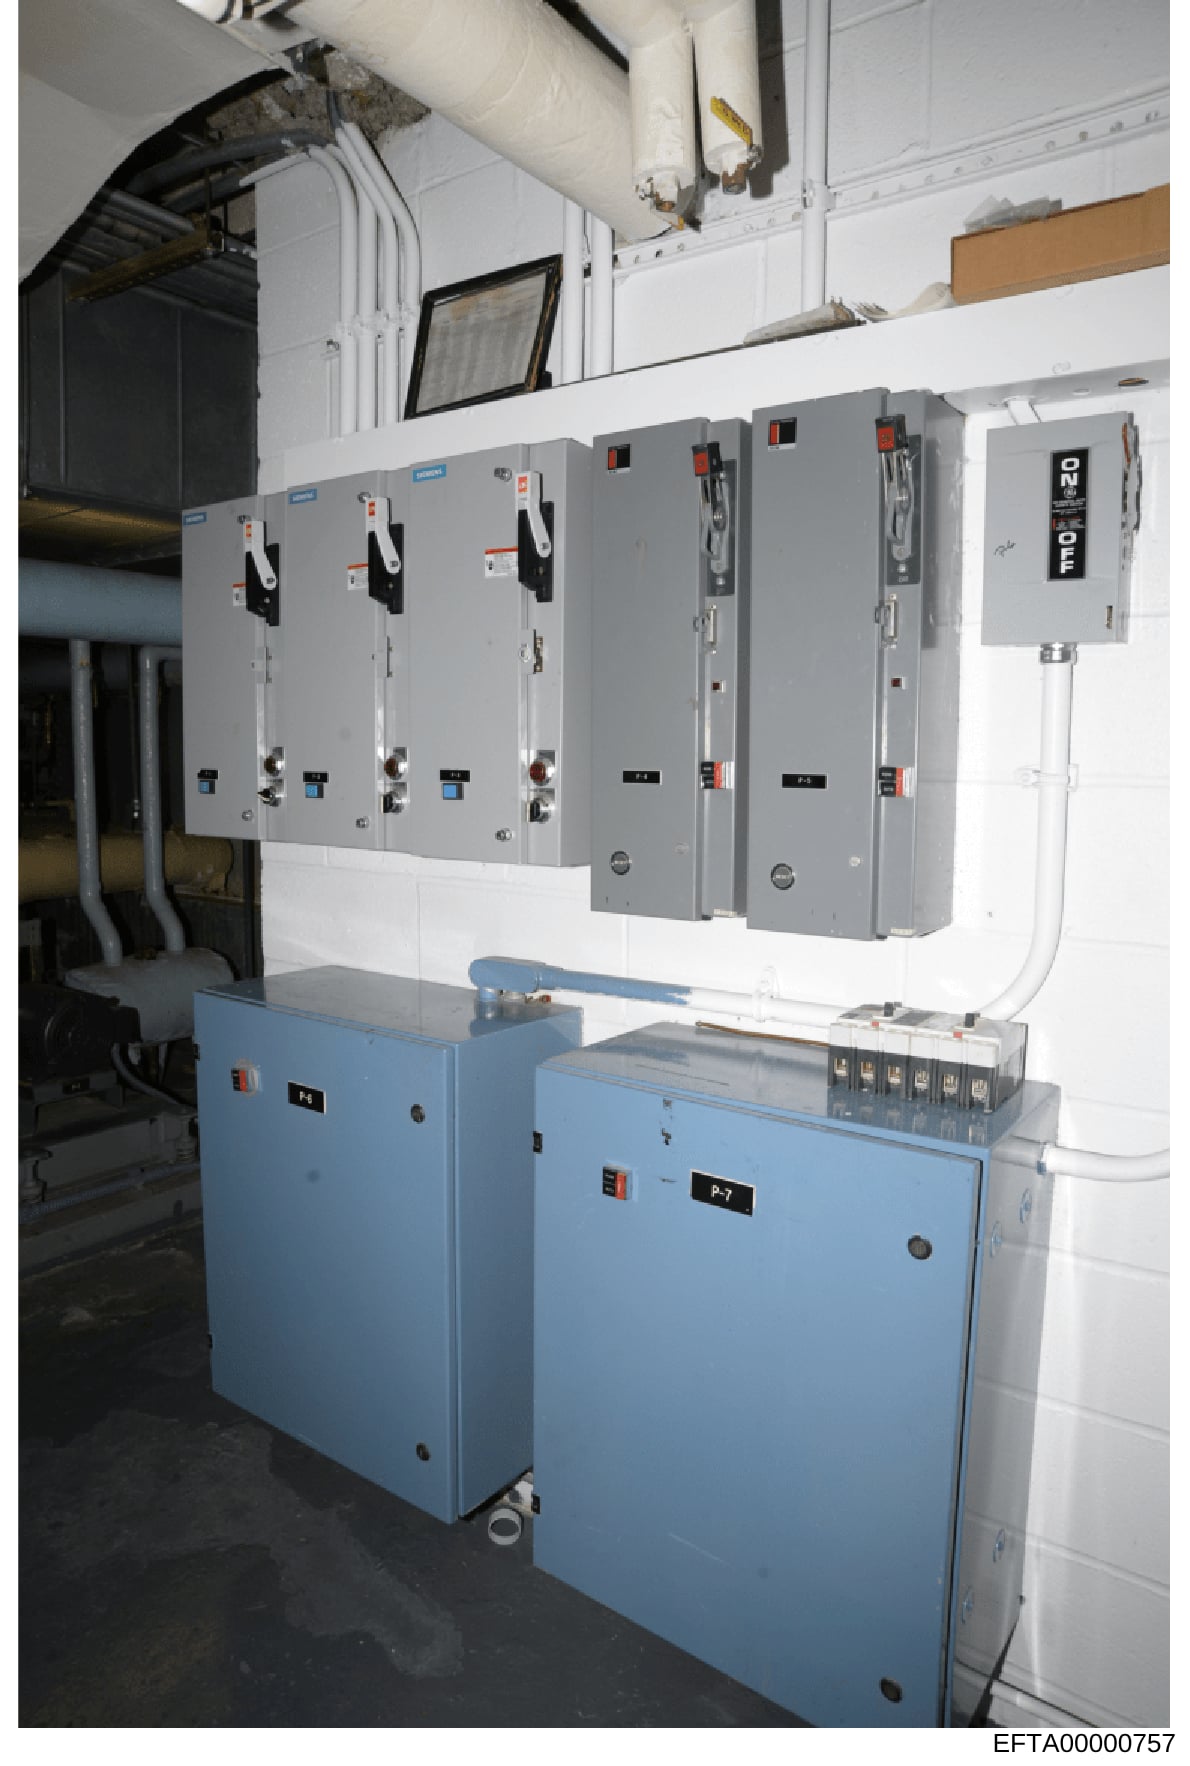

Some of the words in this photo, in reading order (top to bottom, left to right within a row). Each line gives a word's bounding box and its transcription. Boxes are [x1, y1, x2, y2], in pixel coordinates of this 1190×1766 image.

[1060, 457, 1080, 488] ON
[1057, 531, 1078, 575] OFF
[299, 1090, 313, 1105] P-6
[710, 1184, 733, 1203] P-7
